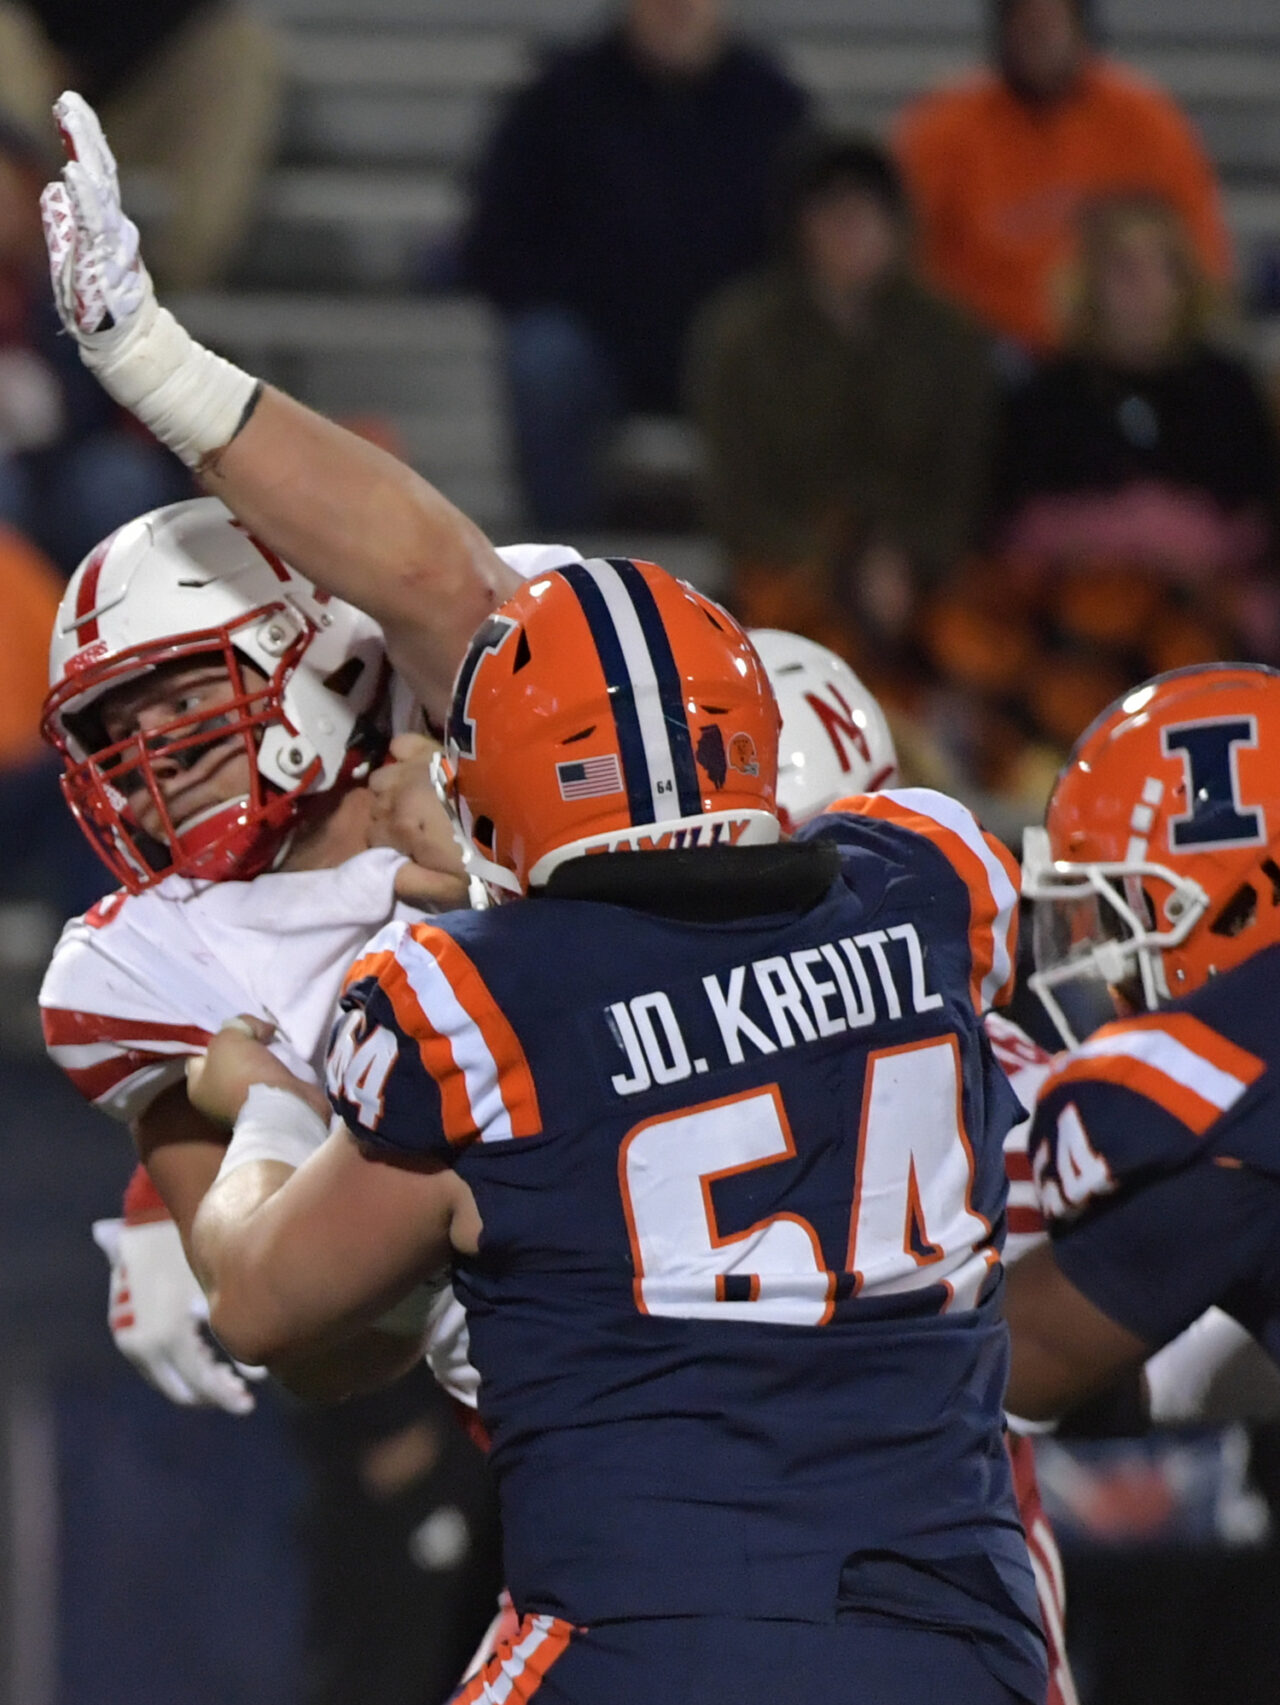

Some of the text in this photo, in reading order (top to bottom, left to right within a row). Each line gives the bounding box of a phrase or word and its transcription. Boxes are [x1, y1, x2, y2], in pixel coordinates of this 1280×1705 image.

[656, 779, 673, 795] 64
[803, 682, 871, 773] N
[1161, 714, 1267, 855] I
[607, 990, 710, 1096] JO.
[701, 922, 944, 1066] KREUTZ
[617, 1032, 1003, 1327] 64
